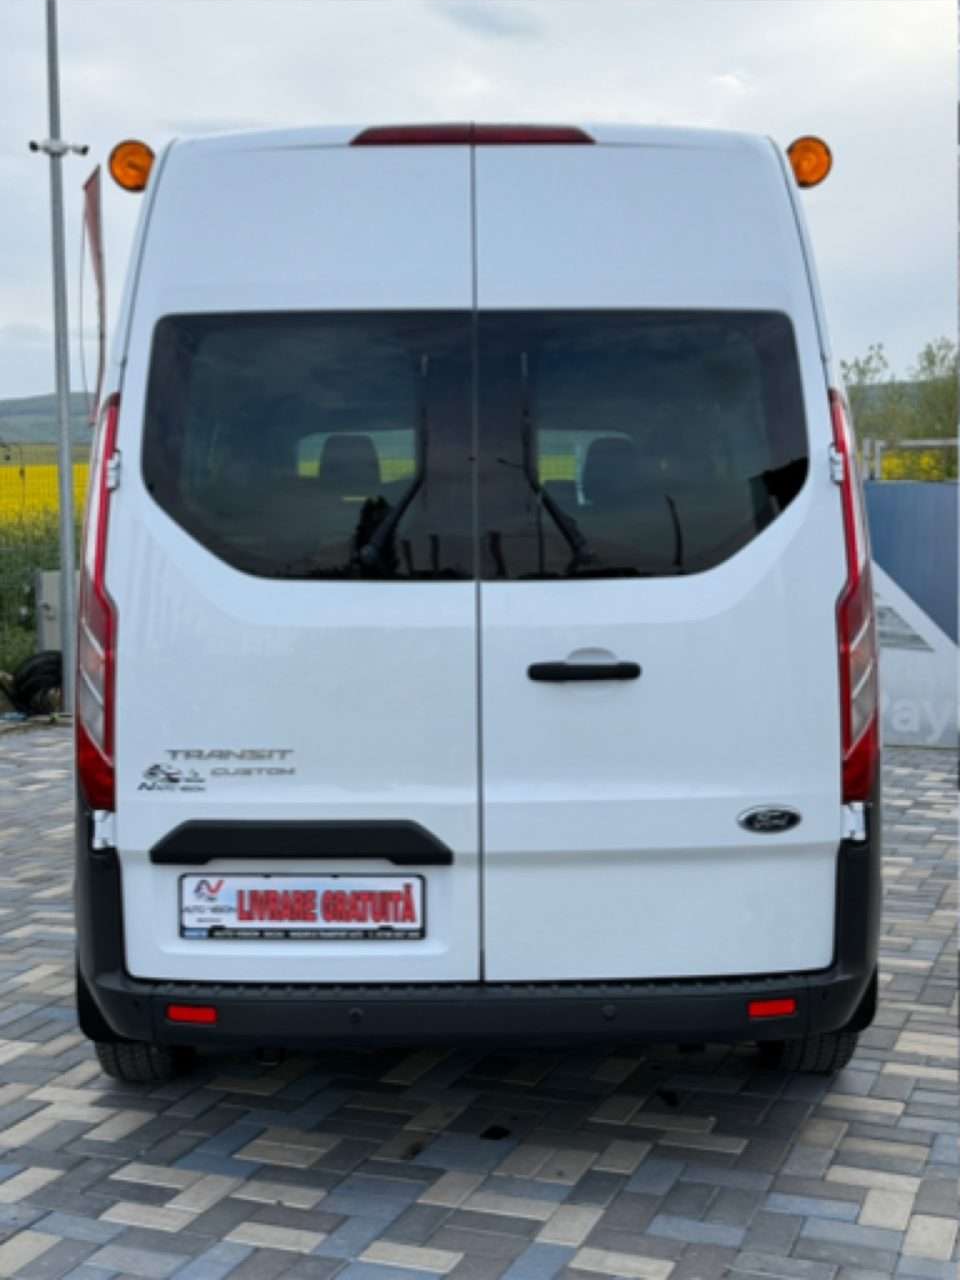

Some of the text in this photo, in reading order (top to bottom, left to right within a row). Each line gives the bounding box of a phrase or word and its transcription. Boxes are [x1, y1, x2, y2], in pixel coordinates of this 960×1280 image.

[165, 749, 294, 762] TRANSIT
[209, 767, 296, 777] CUSTOM
[236, 883, 417, 923] LIVRARE GRATUITĂ
